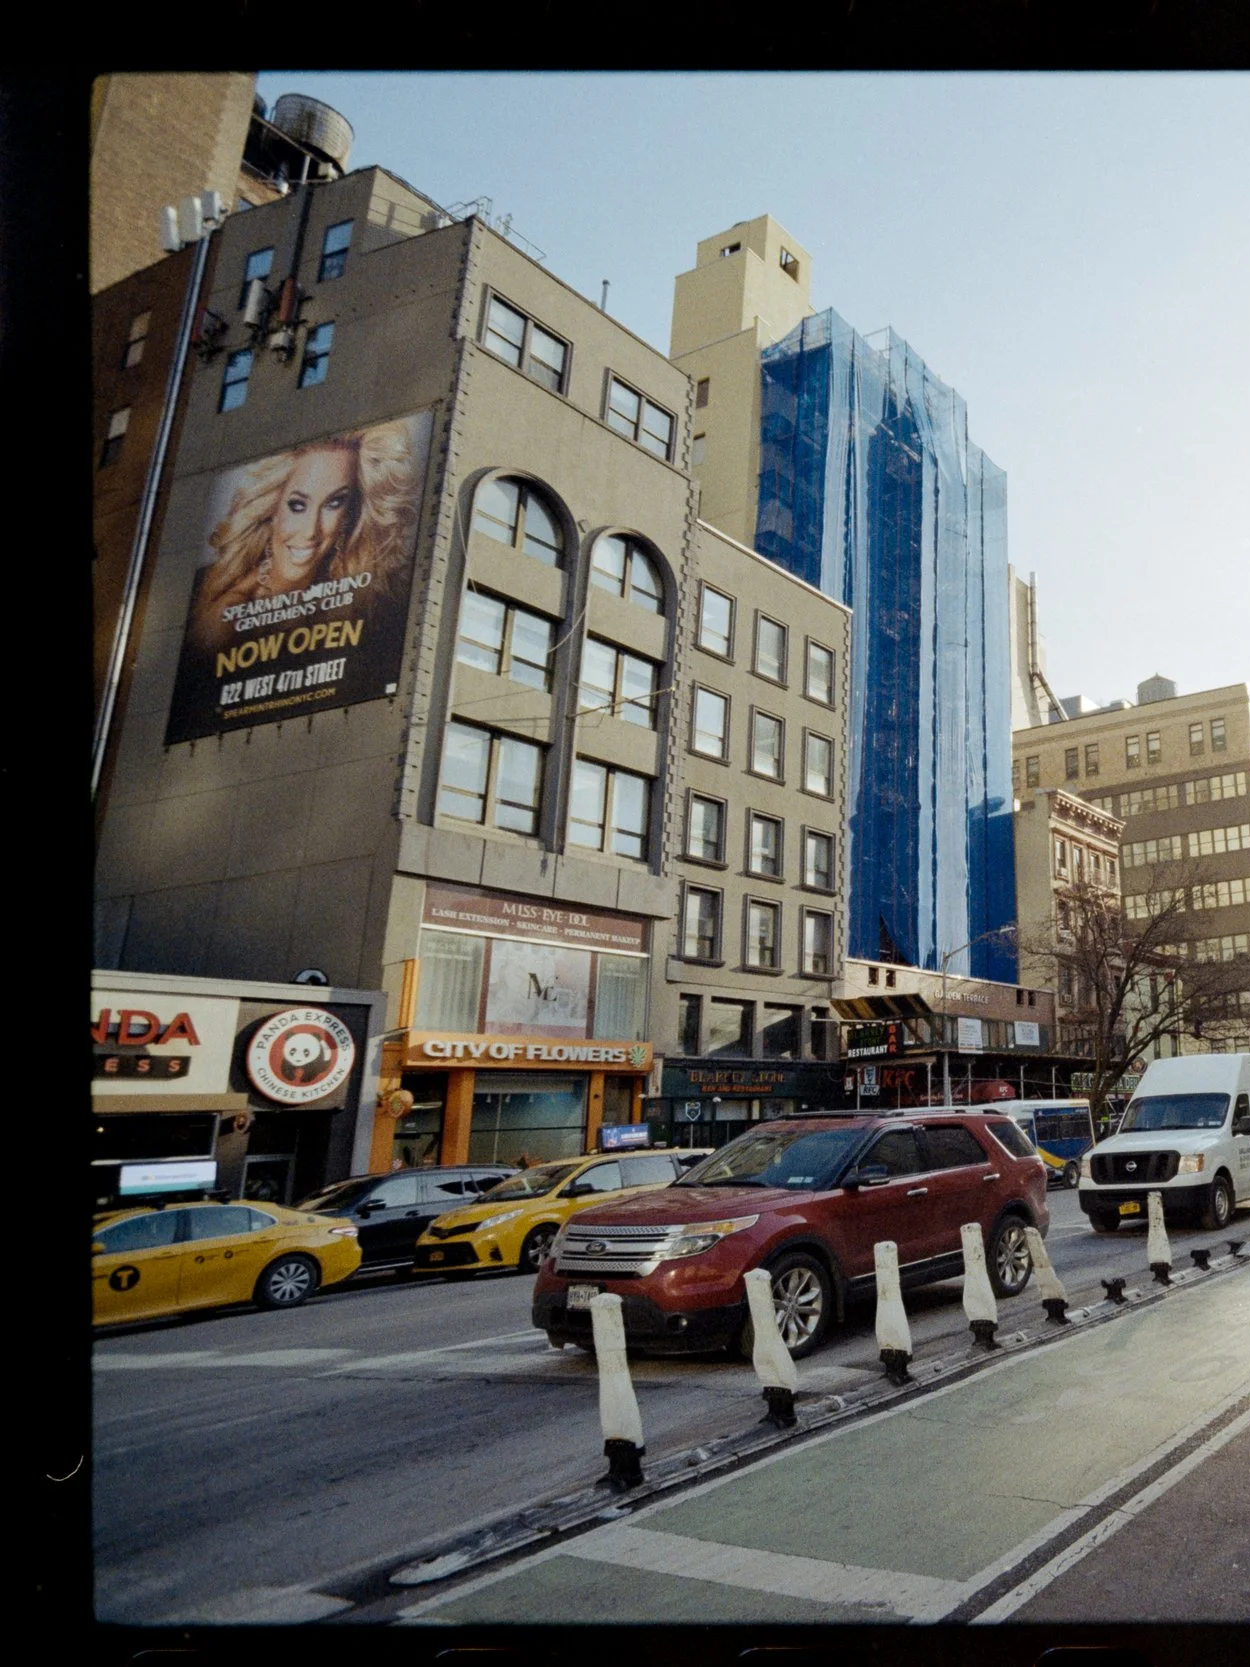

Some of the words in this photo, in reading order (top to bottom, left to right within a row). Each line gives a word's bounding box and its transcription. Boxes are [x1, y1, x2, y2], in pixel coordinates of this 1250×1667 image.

[222, 590, 301, 622] SPEARMINT
[322, 571, 372, 598] RHINO
[321, 592, 354, 611] CLUB
[216, 632, 285, 678] NOW
[287, 619, 364, 654] OPEN
[243, 674, 276, 700] WEST
[276, 669, 304, 693] 47TH
[305, 657, 347, 686] STREET
[432, 907, 457, 919] LASH
[459, 911, 510, 927] EXTENSION
[516, 921, 558, 934] SKINCARE
[564, 928, 610, 941] PERMANENT
[611, 934, 641, 945] MAKEUP
[502, 902, 538, 919] MISS
[542, 908, 564, 923] EYE
[256, 1013, 299, 1051] PANDA
[304, 1011, 351, 1052] EXPRESS
[423, 1039, 487, 1058] CITY
[489, 1042, 527, 1060] OF
[527, 1043, 627, 1064] FLOWERS
[848, 1045, 888, 1058] RESTAURANT
[257, 1067, 297, 1098] CHINESE
[301, 1067, 346, 1098] KITCHEN
[862, 1085, 878, 1093] KFC
[116, 1270, 135, 1290] T
